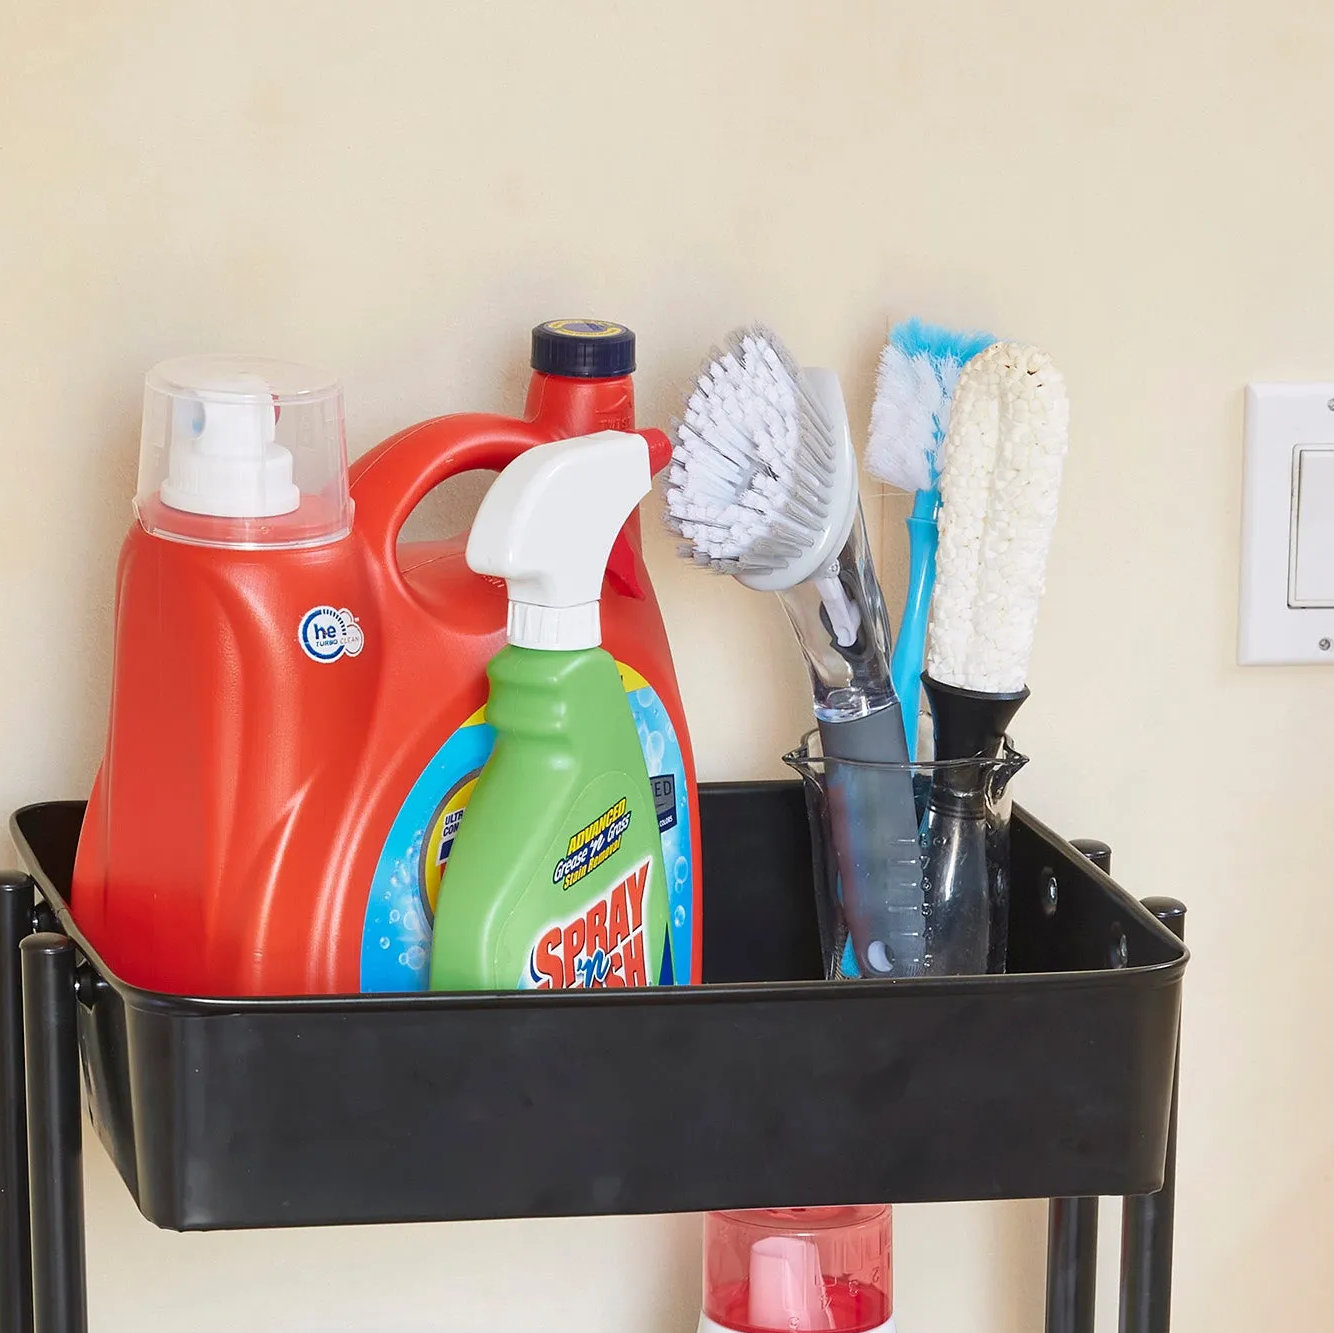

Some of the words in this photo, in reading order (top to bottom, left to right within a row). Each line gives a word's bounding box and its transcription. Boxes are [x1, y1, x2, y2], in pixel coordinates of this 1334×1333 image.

[313, 623, 336, 640] he
[316, 638, 338, 647] TURBO
[652, 780, 672, 797] ED
[567, 798, 626, 855] ADVANCED
[554, 847, 589, 882] Grease
[607, 813, 630, 842] Grass
[564, 864, 587, 889] Stain
[536, 861, 650, 989] SPRAY
